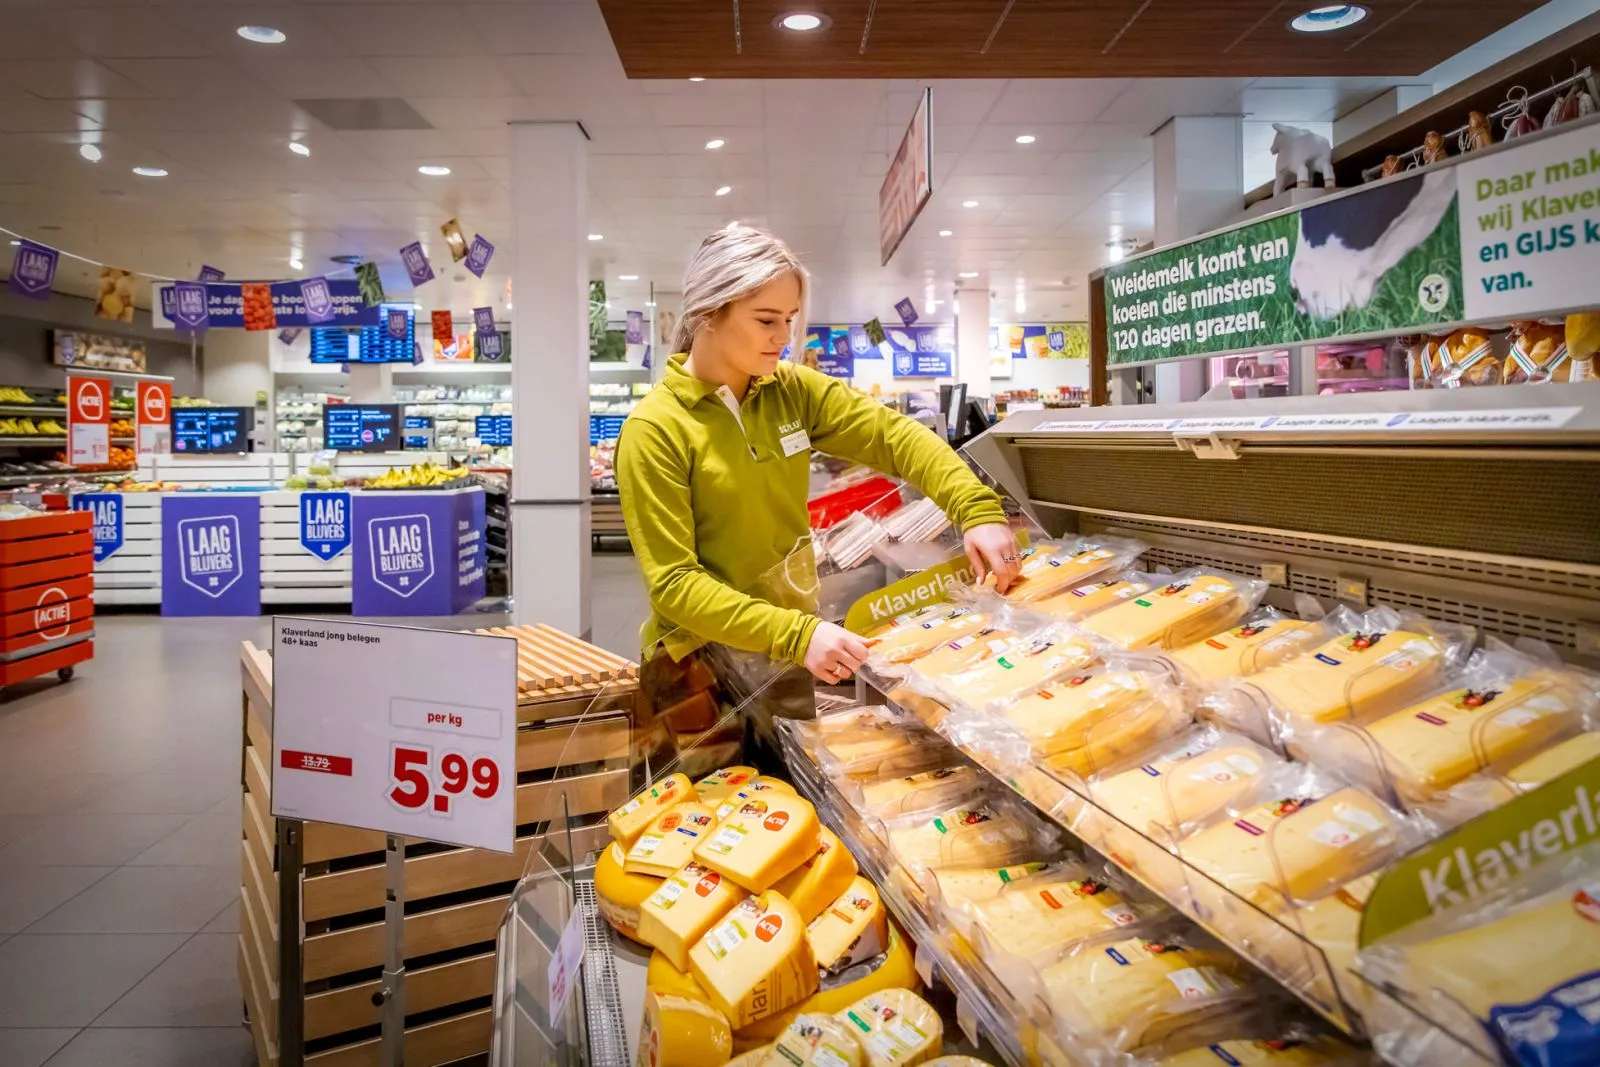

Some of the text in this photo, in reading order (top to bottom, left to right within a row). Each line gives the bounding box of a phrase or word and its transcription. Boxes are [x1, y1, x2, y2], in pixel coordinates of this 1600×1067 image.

[1476, 170, 1537, 202] Daar
[1477, 203, 1513, 231] wij
[1479, 242, 1509, 263] en
[1515, 224, 1576, 255] GIJS
[1111, 236, 1289, 298] Weidemelk komt van
[1480, 270, 1533, 294] van.
[1112, 273, 1276, 324] koeien die minstens
[1112, 309, 1266, 351] 120 dagen grazen.
[306, 498, 344, 525] LAAG
[187, 524, 231, 556] LAAG
[378, 524, 422, 556] LAAG
[39, 605, 67, 623] ACTIE
[281, 627, 381, 644] Klaverland jong belegen
[299, 638, 318, 647] kaas
[427, 711, 463, 727] per kg
[390, 748, 500, 813] 5.99
